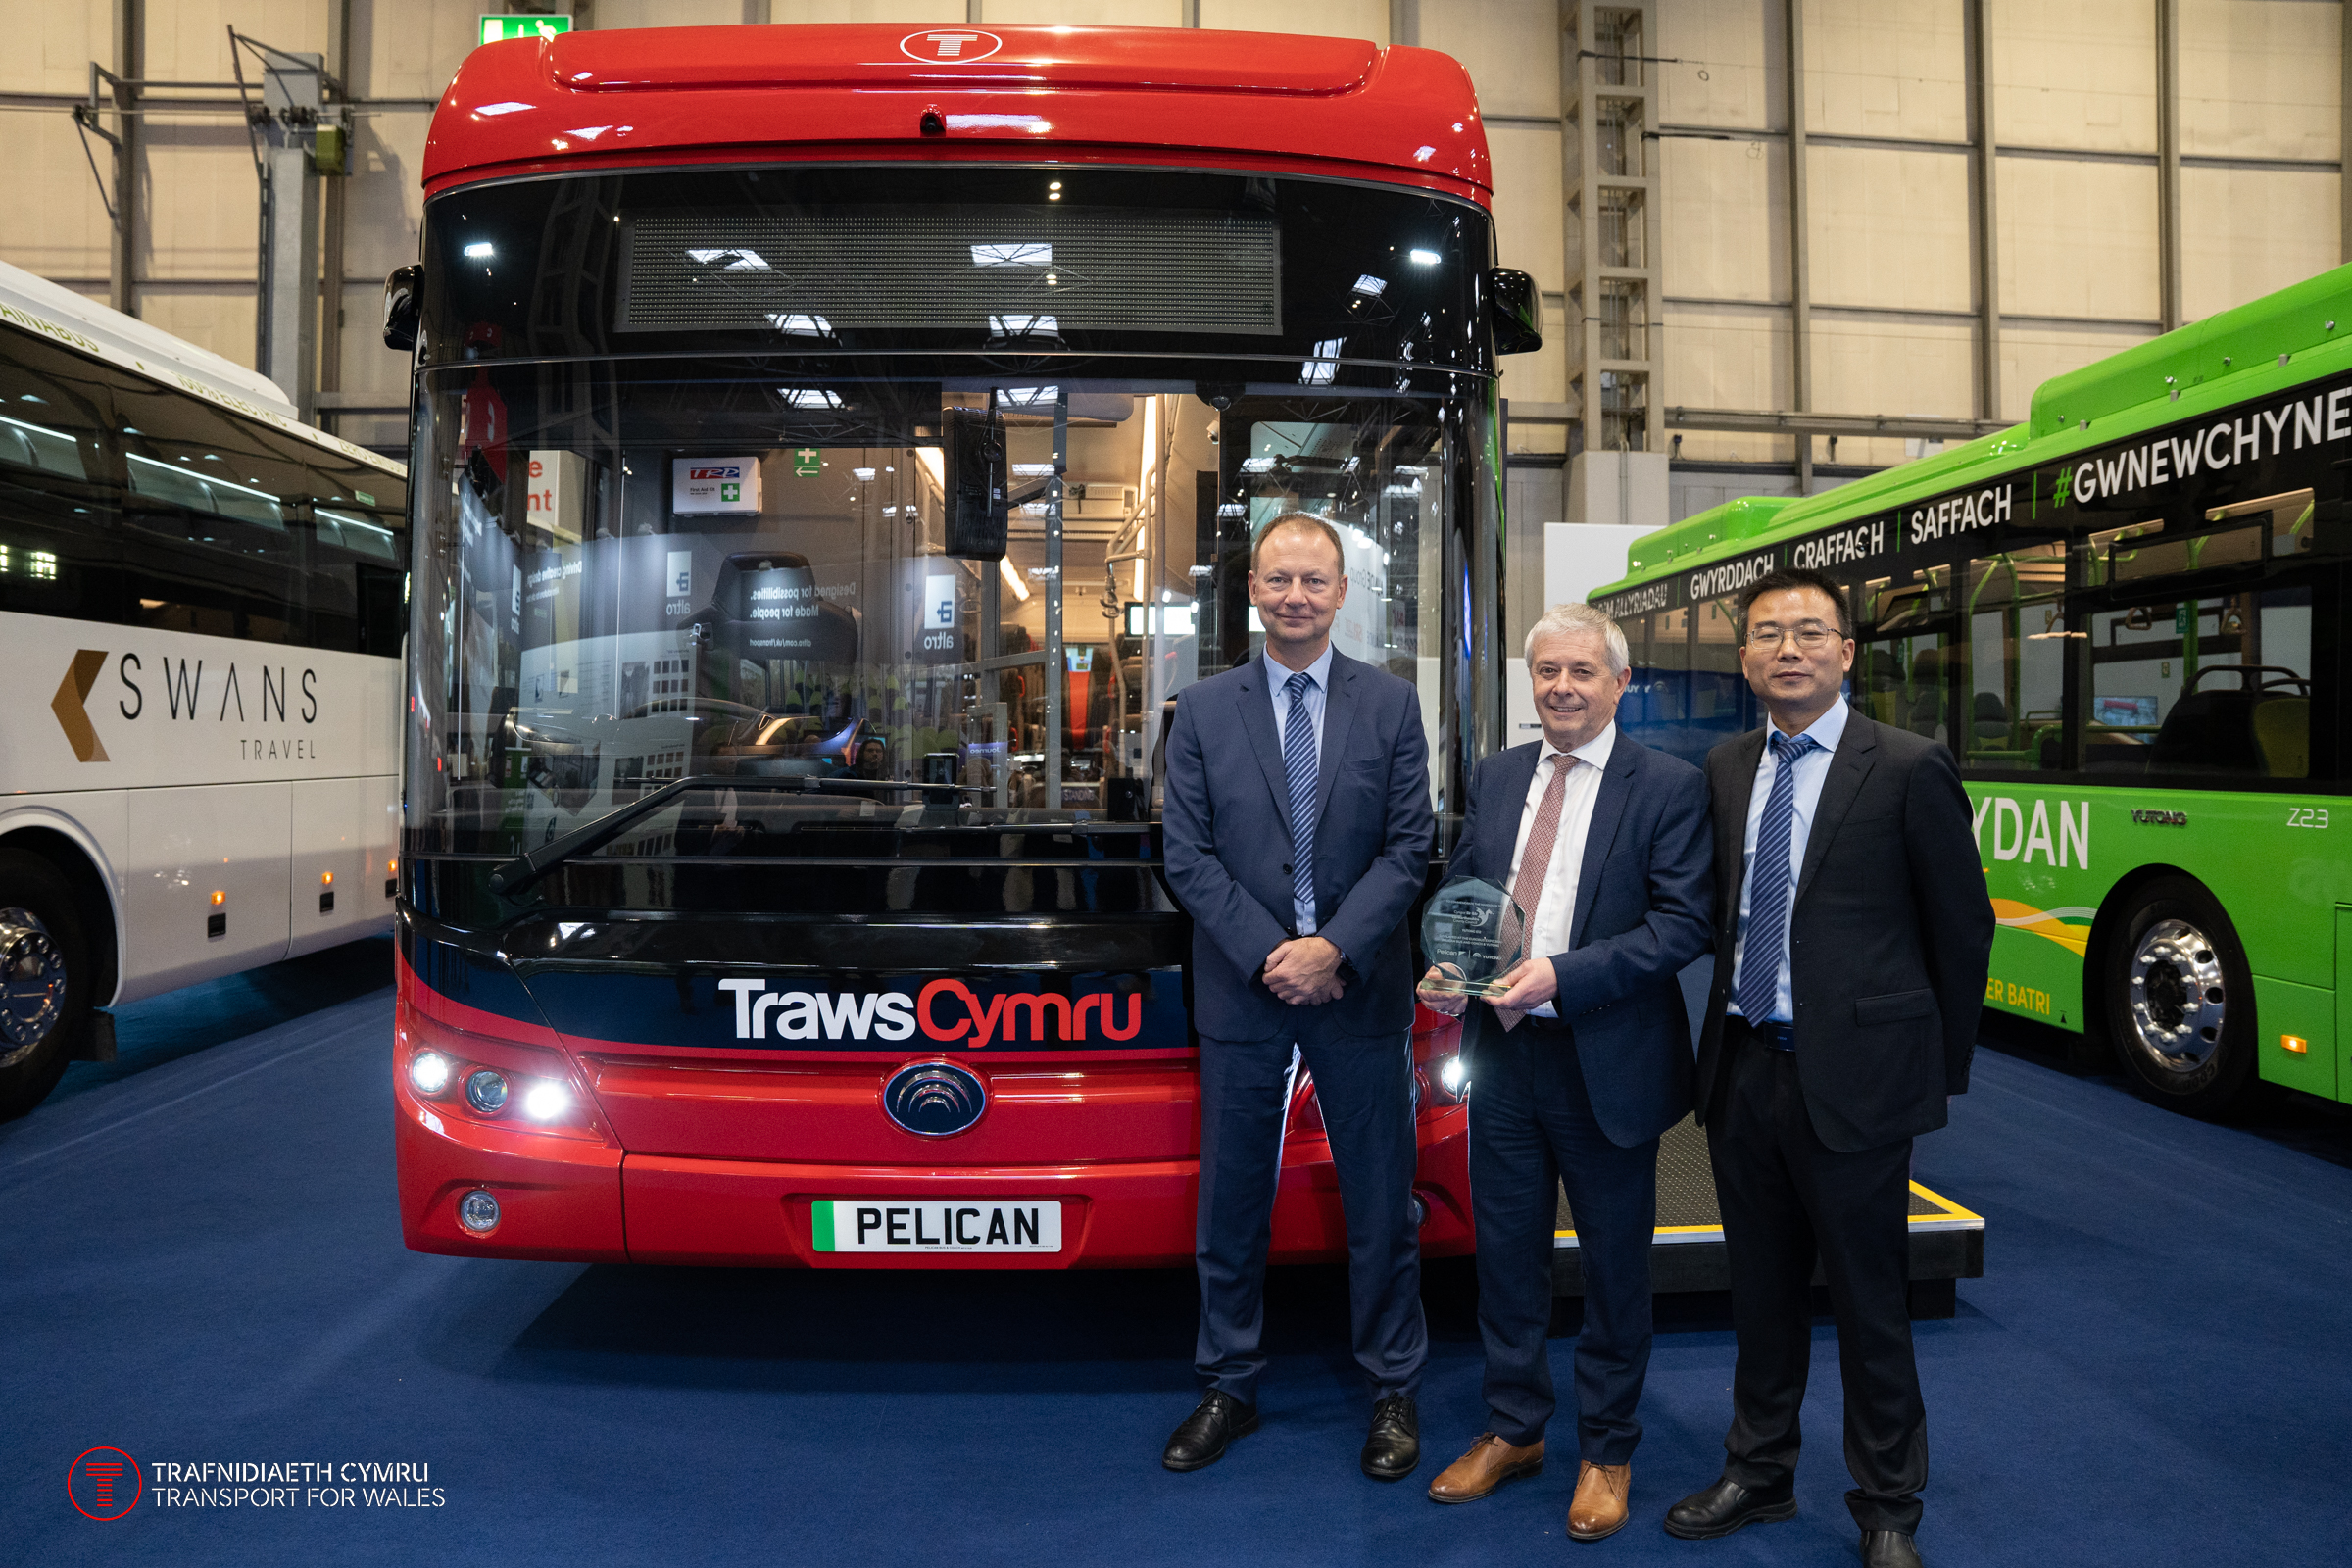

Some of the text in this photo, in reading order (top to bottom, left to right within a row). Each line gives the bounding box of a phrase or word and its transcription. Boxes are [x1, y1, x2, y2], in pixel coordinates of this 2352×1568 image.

[2053, 386, 2352, 508] #GWNEWCHYNE
[690, 467, 740, 479] TRP
[1911, 484, 2012, 545] SAFFACH
[1793, 520, 1884, 569] CRAFFACH
[1690, 553, 1774, 600] GWYRDDACH
[1614, 583, 1668, 619] ALLYRIADAU
[120, 653, 318, 723] SWANS
[240, 740, 316, 760] TRAVEL
[2132, 808, 2187, 826] YUTONG
[2286, 808, 2328, 829] Z23
[718, 978, 1142, 1048] TrawsCymru
[2007, 982, 2050, 1016] BATRI
[857, 1207, 1040, 1245] PELICAN
